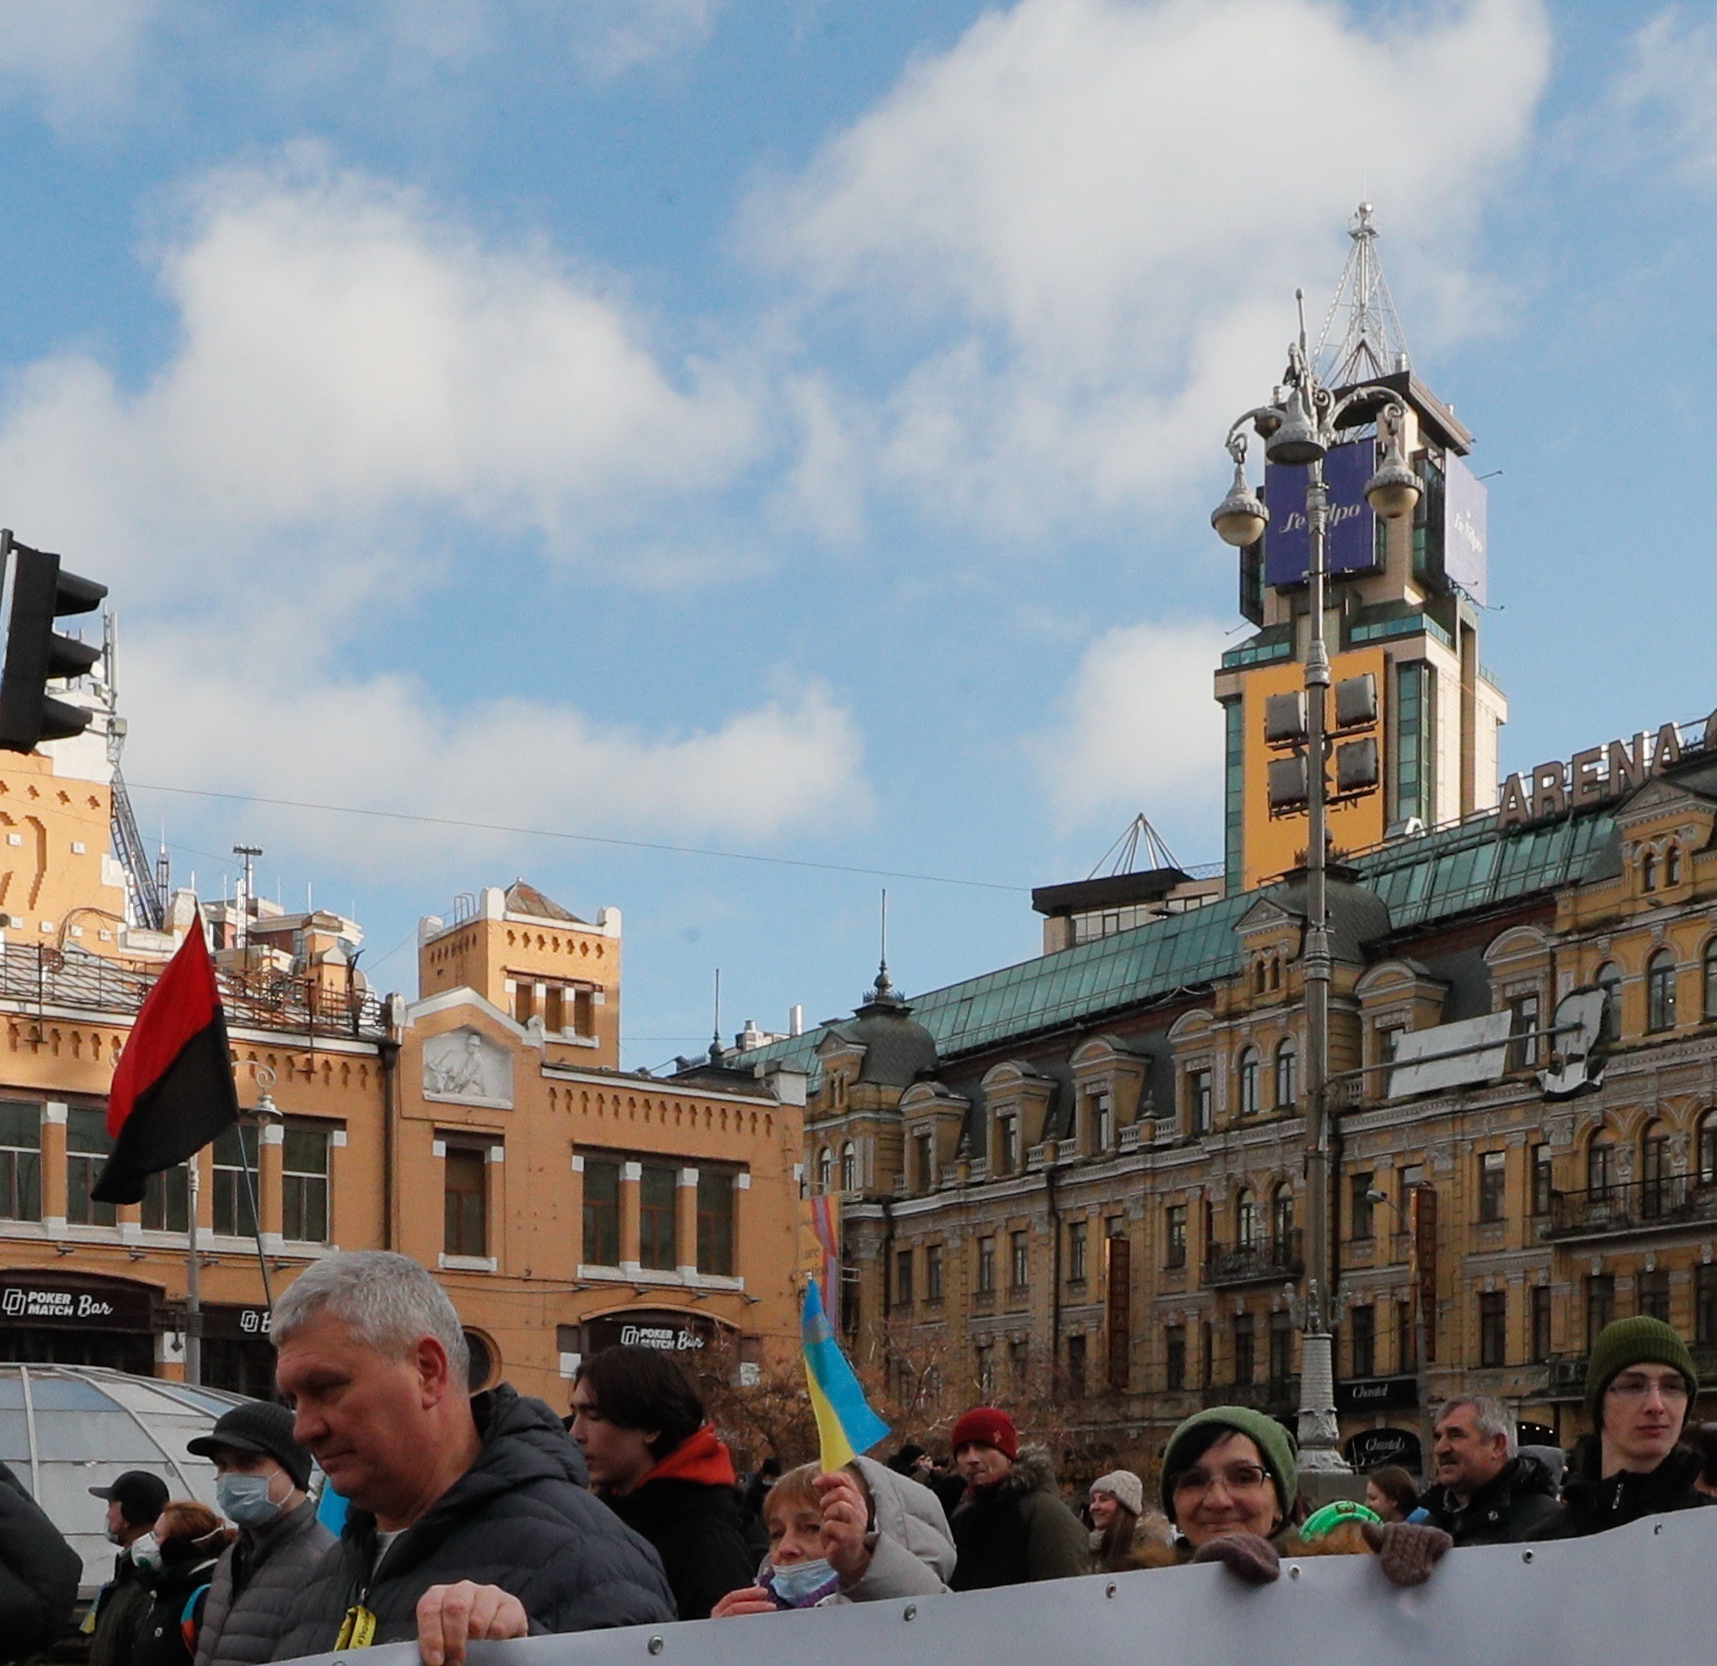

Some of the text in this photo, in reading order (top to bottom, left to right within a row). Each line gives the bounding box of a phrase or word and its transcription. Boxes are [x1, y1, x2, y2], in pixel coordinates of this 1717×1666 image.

[1495, 721, 1685, 830] ARENA
[27, 1291, 72, 1304] POKER
[27, 1295, 114, 1317] MATCH Bar
[640, 1328, 674, 1339] POKER
